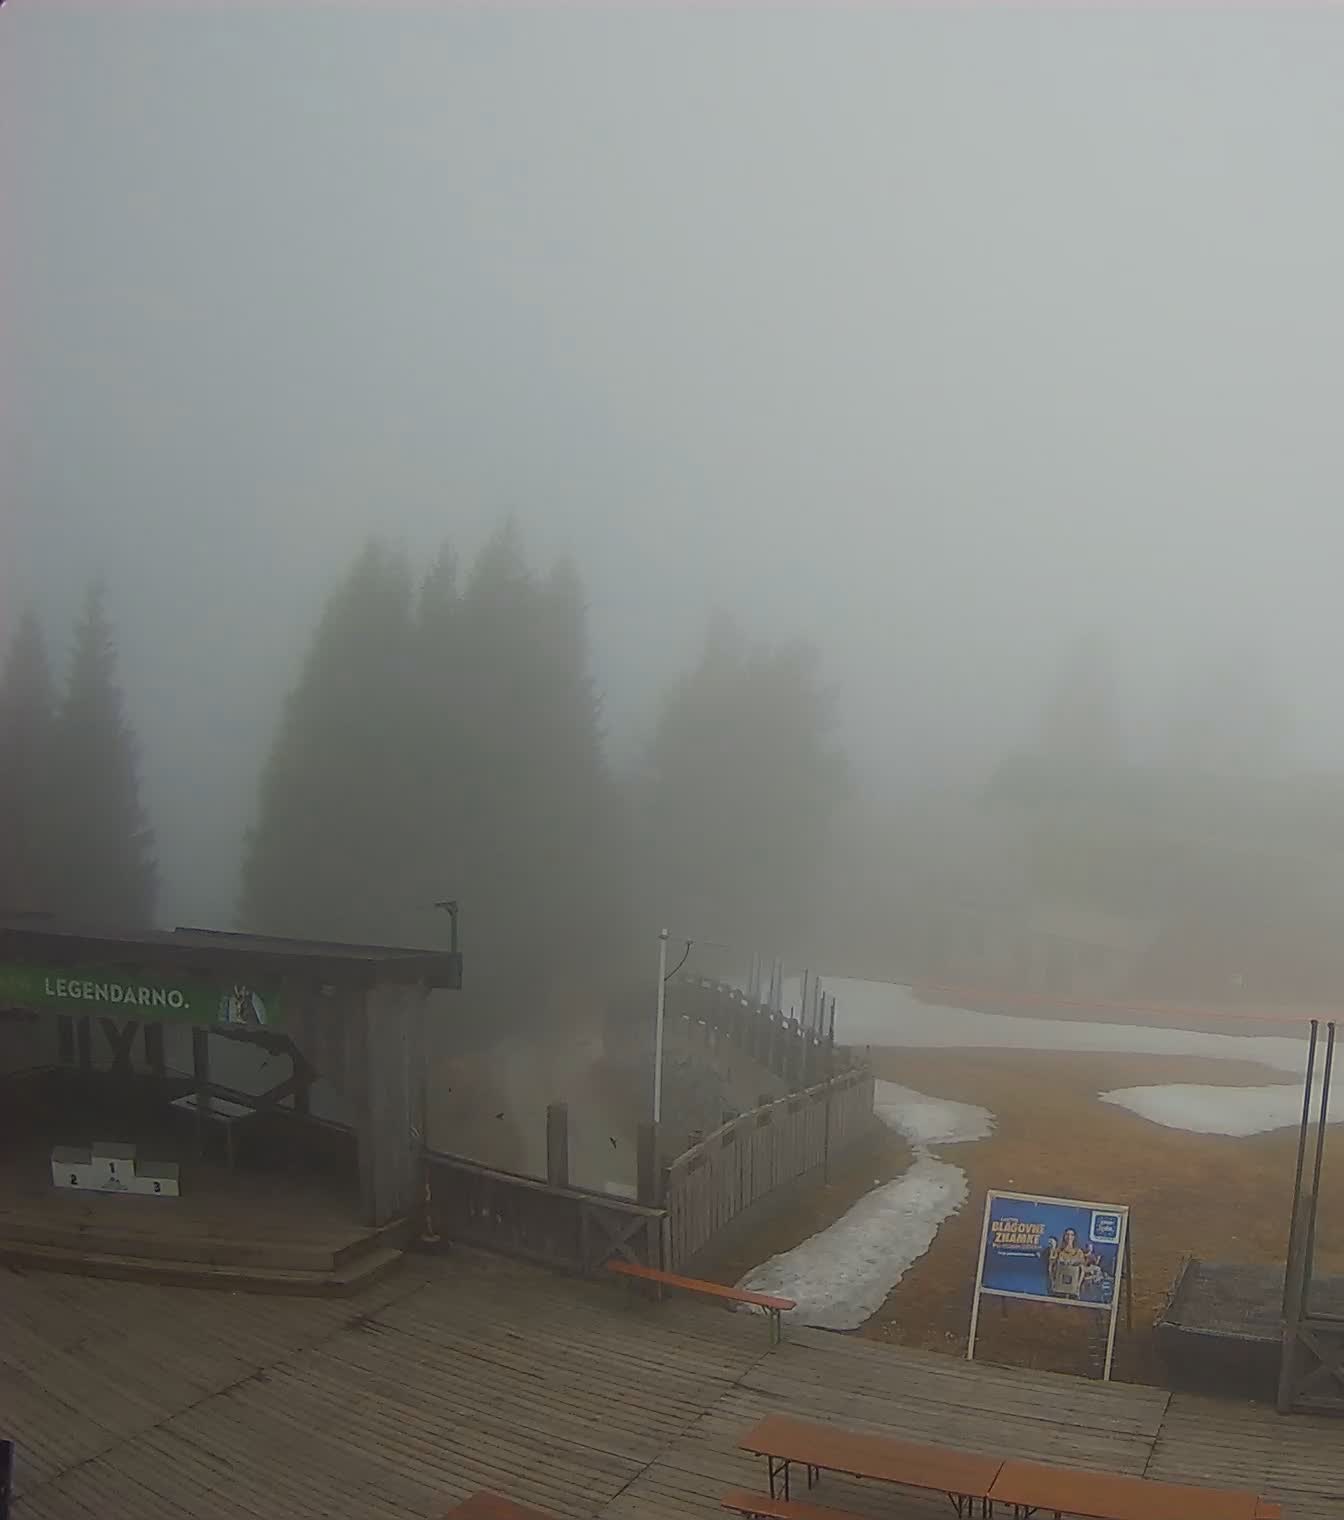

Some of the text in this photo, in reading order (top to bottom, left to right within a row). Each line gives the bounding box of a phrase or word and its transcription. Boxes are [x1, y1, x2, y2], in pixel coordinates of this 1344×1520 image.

[44, 977, 190, 1009] LEGENDARNO.
[109, 1162, 115, 1174] 1
[70, 1174, 78, 1185] 2
[153, 1181, 161, 1193] 3
[991, 1221, 1046, 1234] BLAGOVNE
